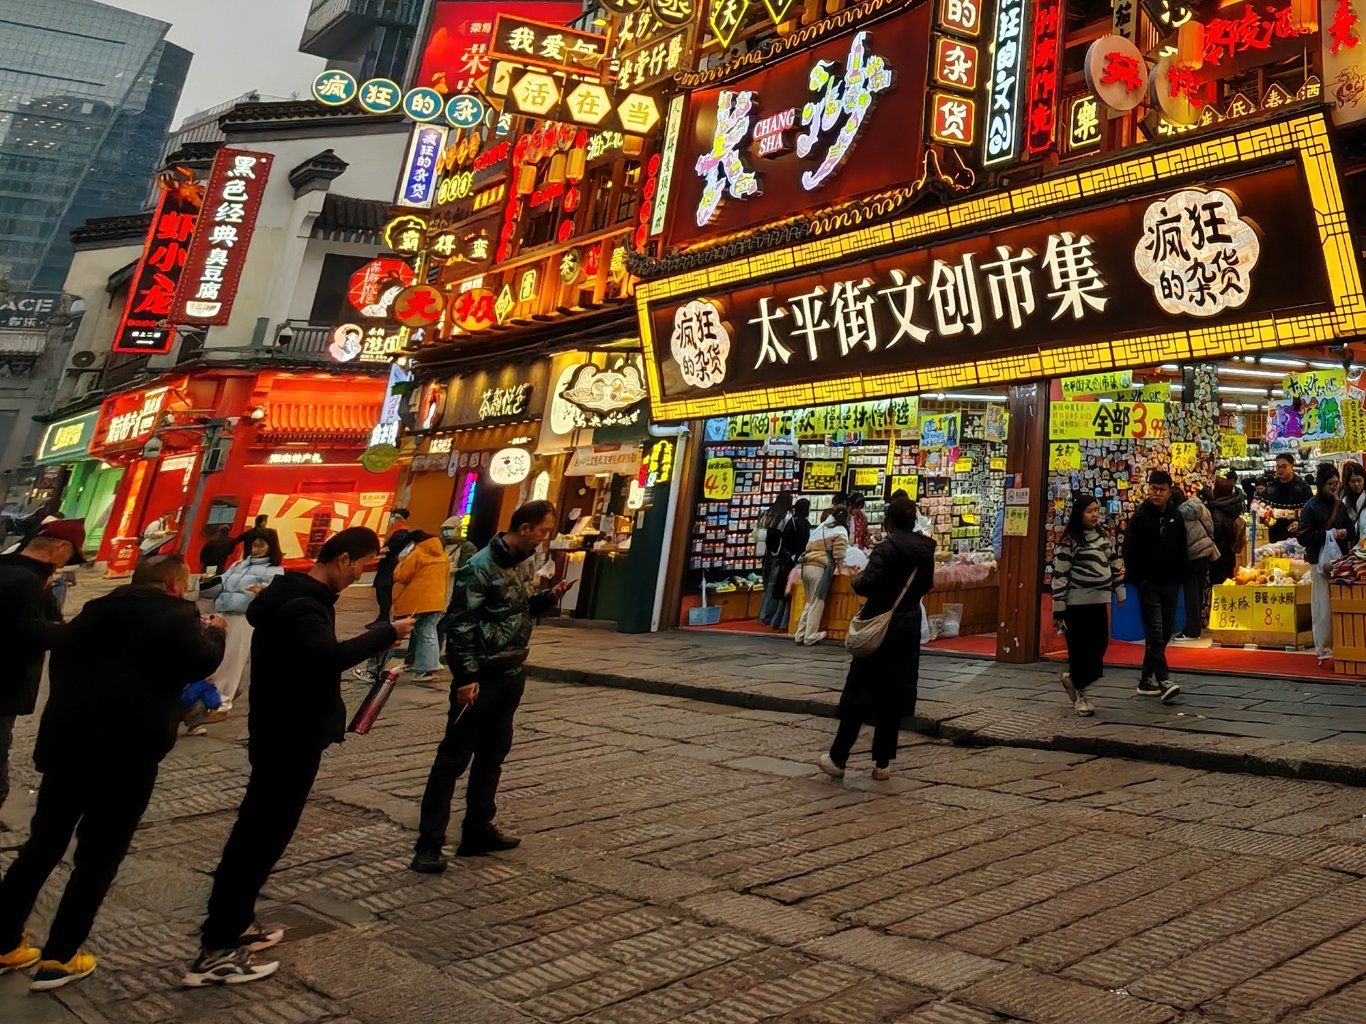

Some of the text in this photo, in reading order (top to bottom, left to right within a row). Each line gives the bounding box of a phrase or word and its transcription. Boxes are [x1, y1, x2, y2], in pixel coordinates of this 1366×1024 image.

[695, 31, 892, 227] 长沙
[753, 107, 796, 140] CHANG
[758, 132, 784, 158] SHA
[409, 132, 439, 199] 疯狂的杂货
[193, 155, 259, 301] 黑色经典臭豆腐
[1146, 202, 1232, 261] 疯狂
[747, 233, 1108, 372] 太平街文创市集
[1159, 247, 1246, 306] 的杂货
[1091, 403, 1131, 438] 全部
